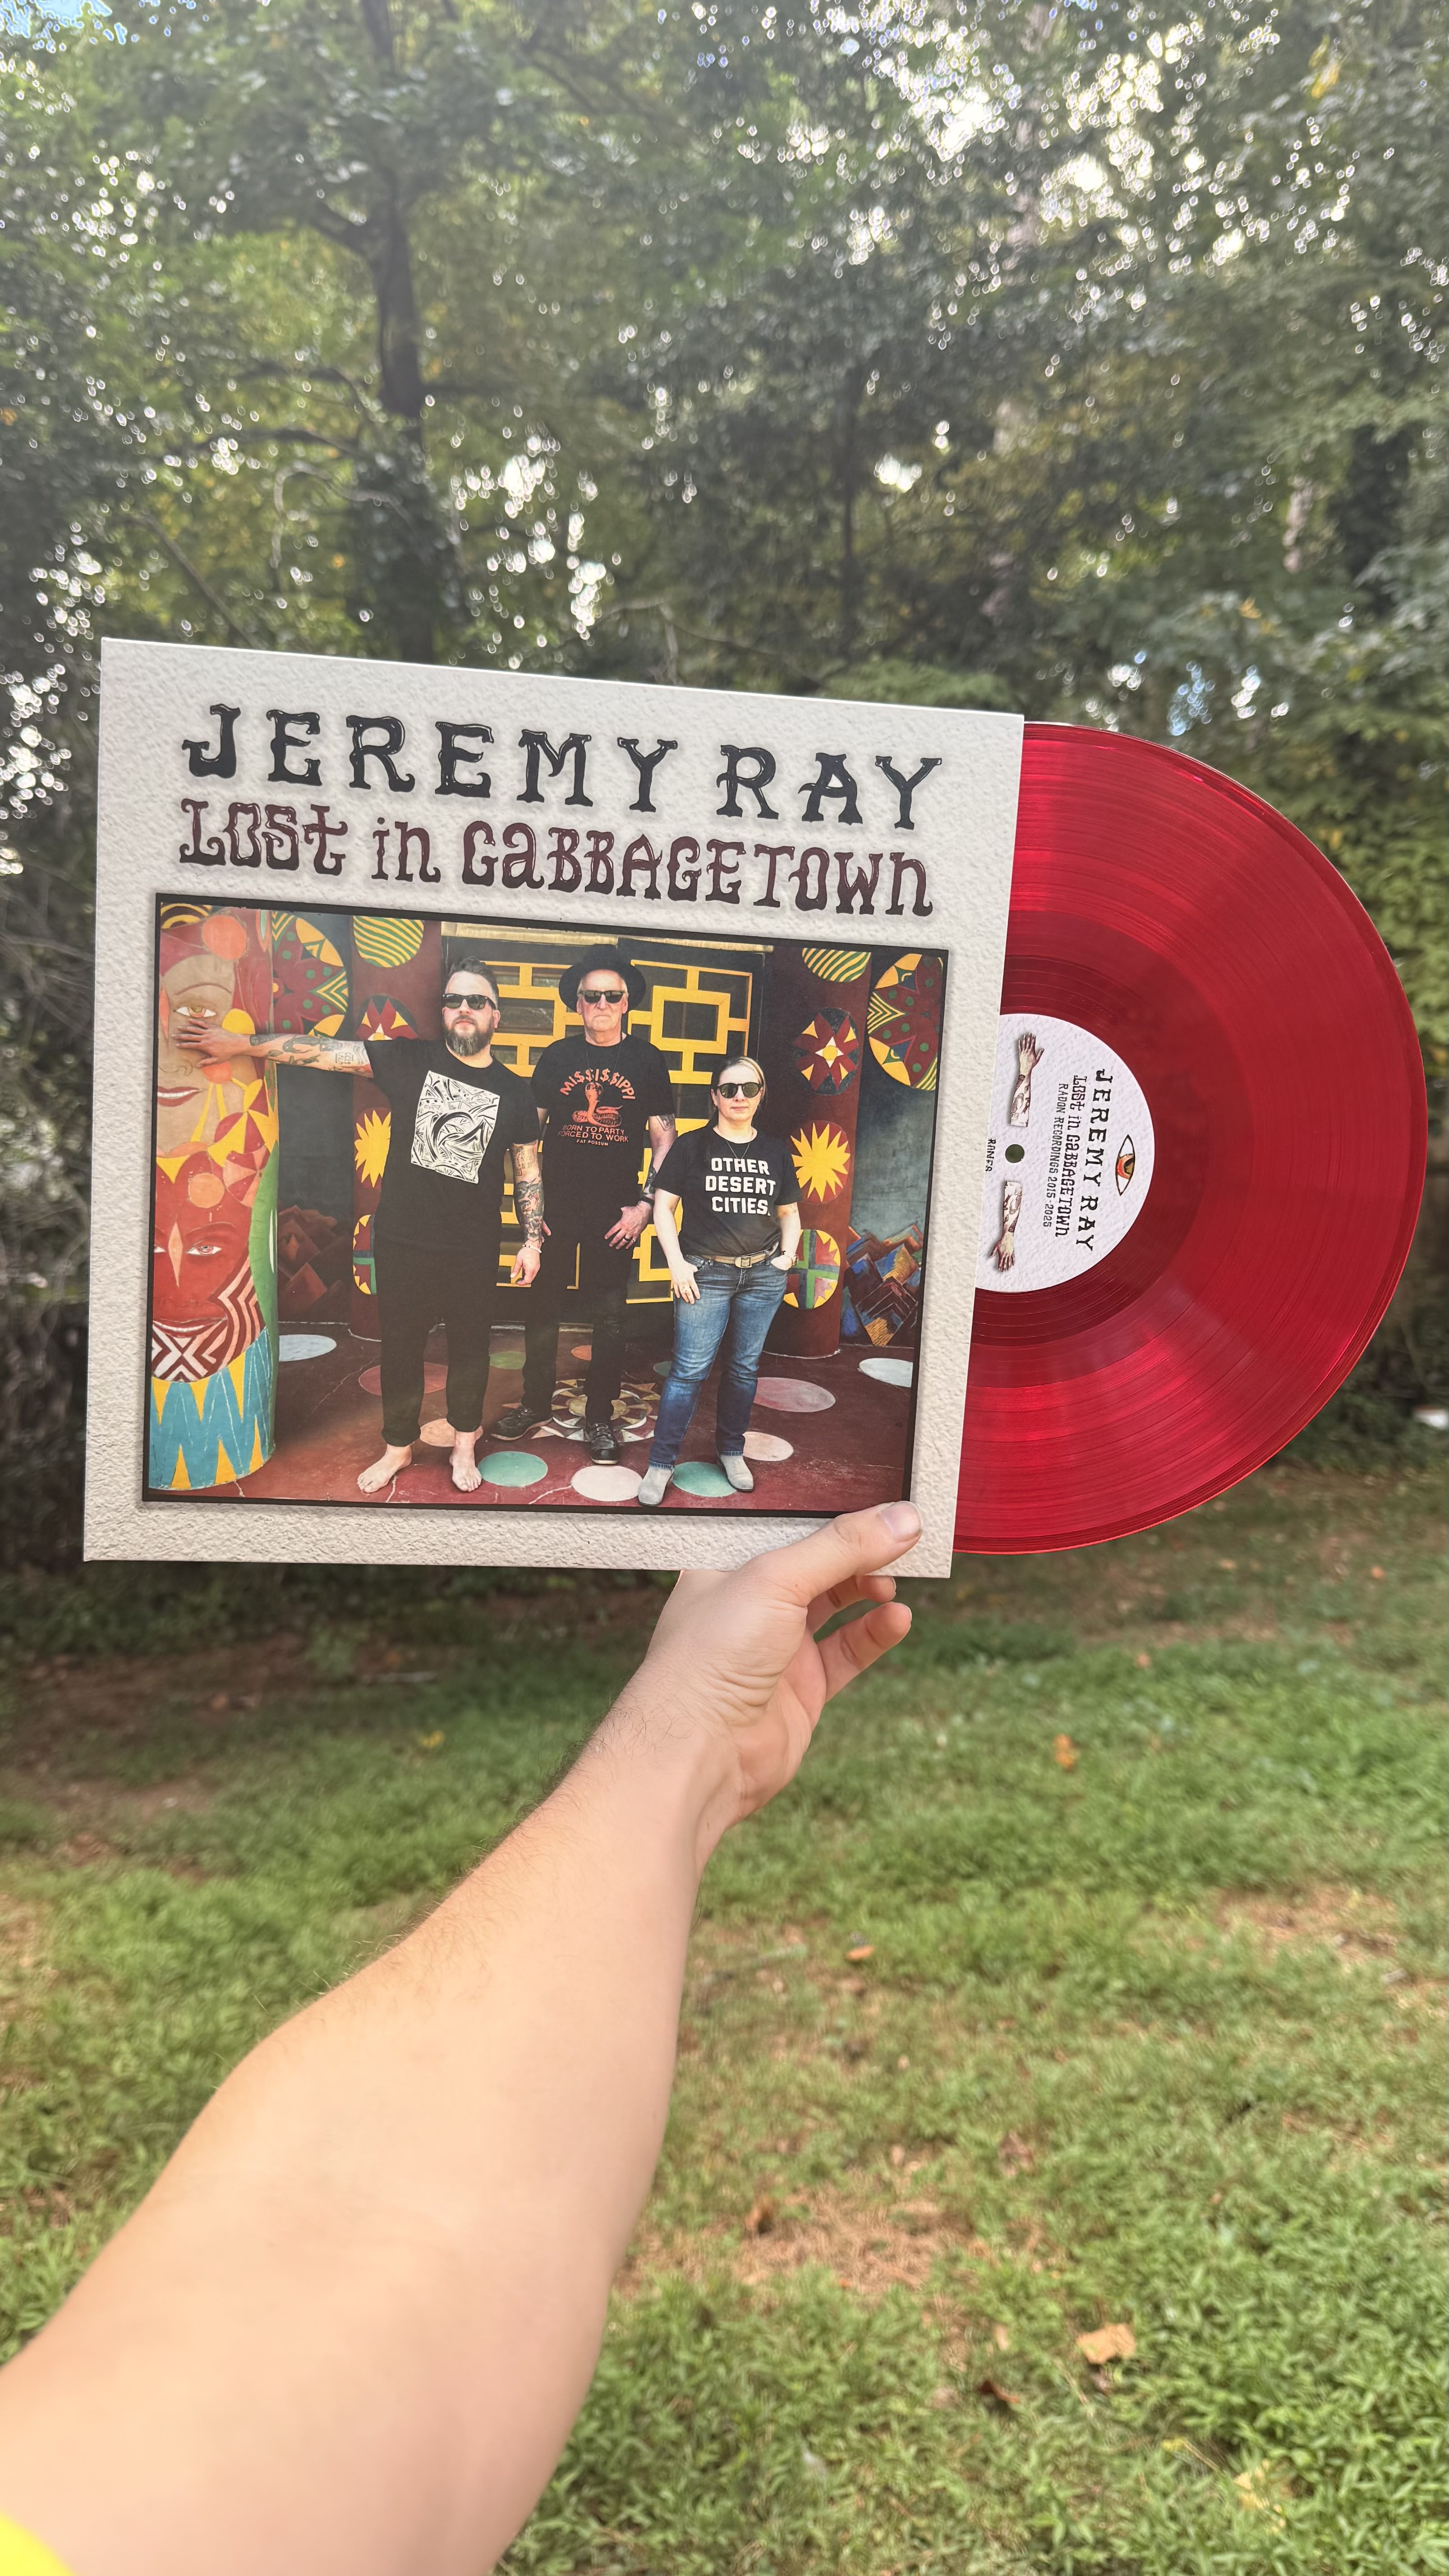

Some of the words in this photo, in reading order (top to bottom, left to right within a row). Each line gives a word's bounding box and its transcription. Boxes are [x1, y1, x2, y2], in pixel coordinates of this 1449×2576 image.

[181, 703, 678, 813] JEREMY
[716, 745, 942, 830] RAY
[371, 817, 441, 883] in
[1055, 1083, 1068, 1114] RADON
[599, 1127, 625, 1135] PARTY
[1067, 1114, 1082, 1130] in
[1083, 1068, 1113, 1187] JEREMY
[606, 1134, 629, 1142] WORK
[1049, 1117, 1064, 1174] RECORDINGS
[711, 1157, 770, 1175] OTHER
[705, 1175, 776, 1196] DESERT
[1076, 1195, 1099, 1251] RAY
